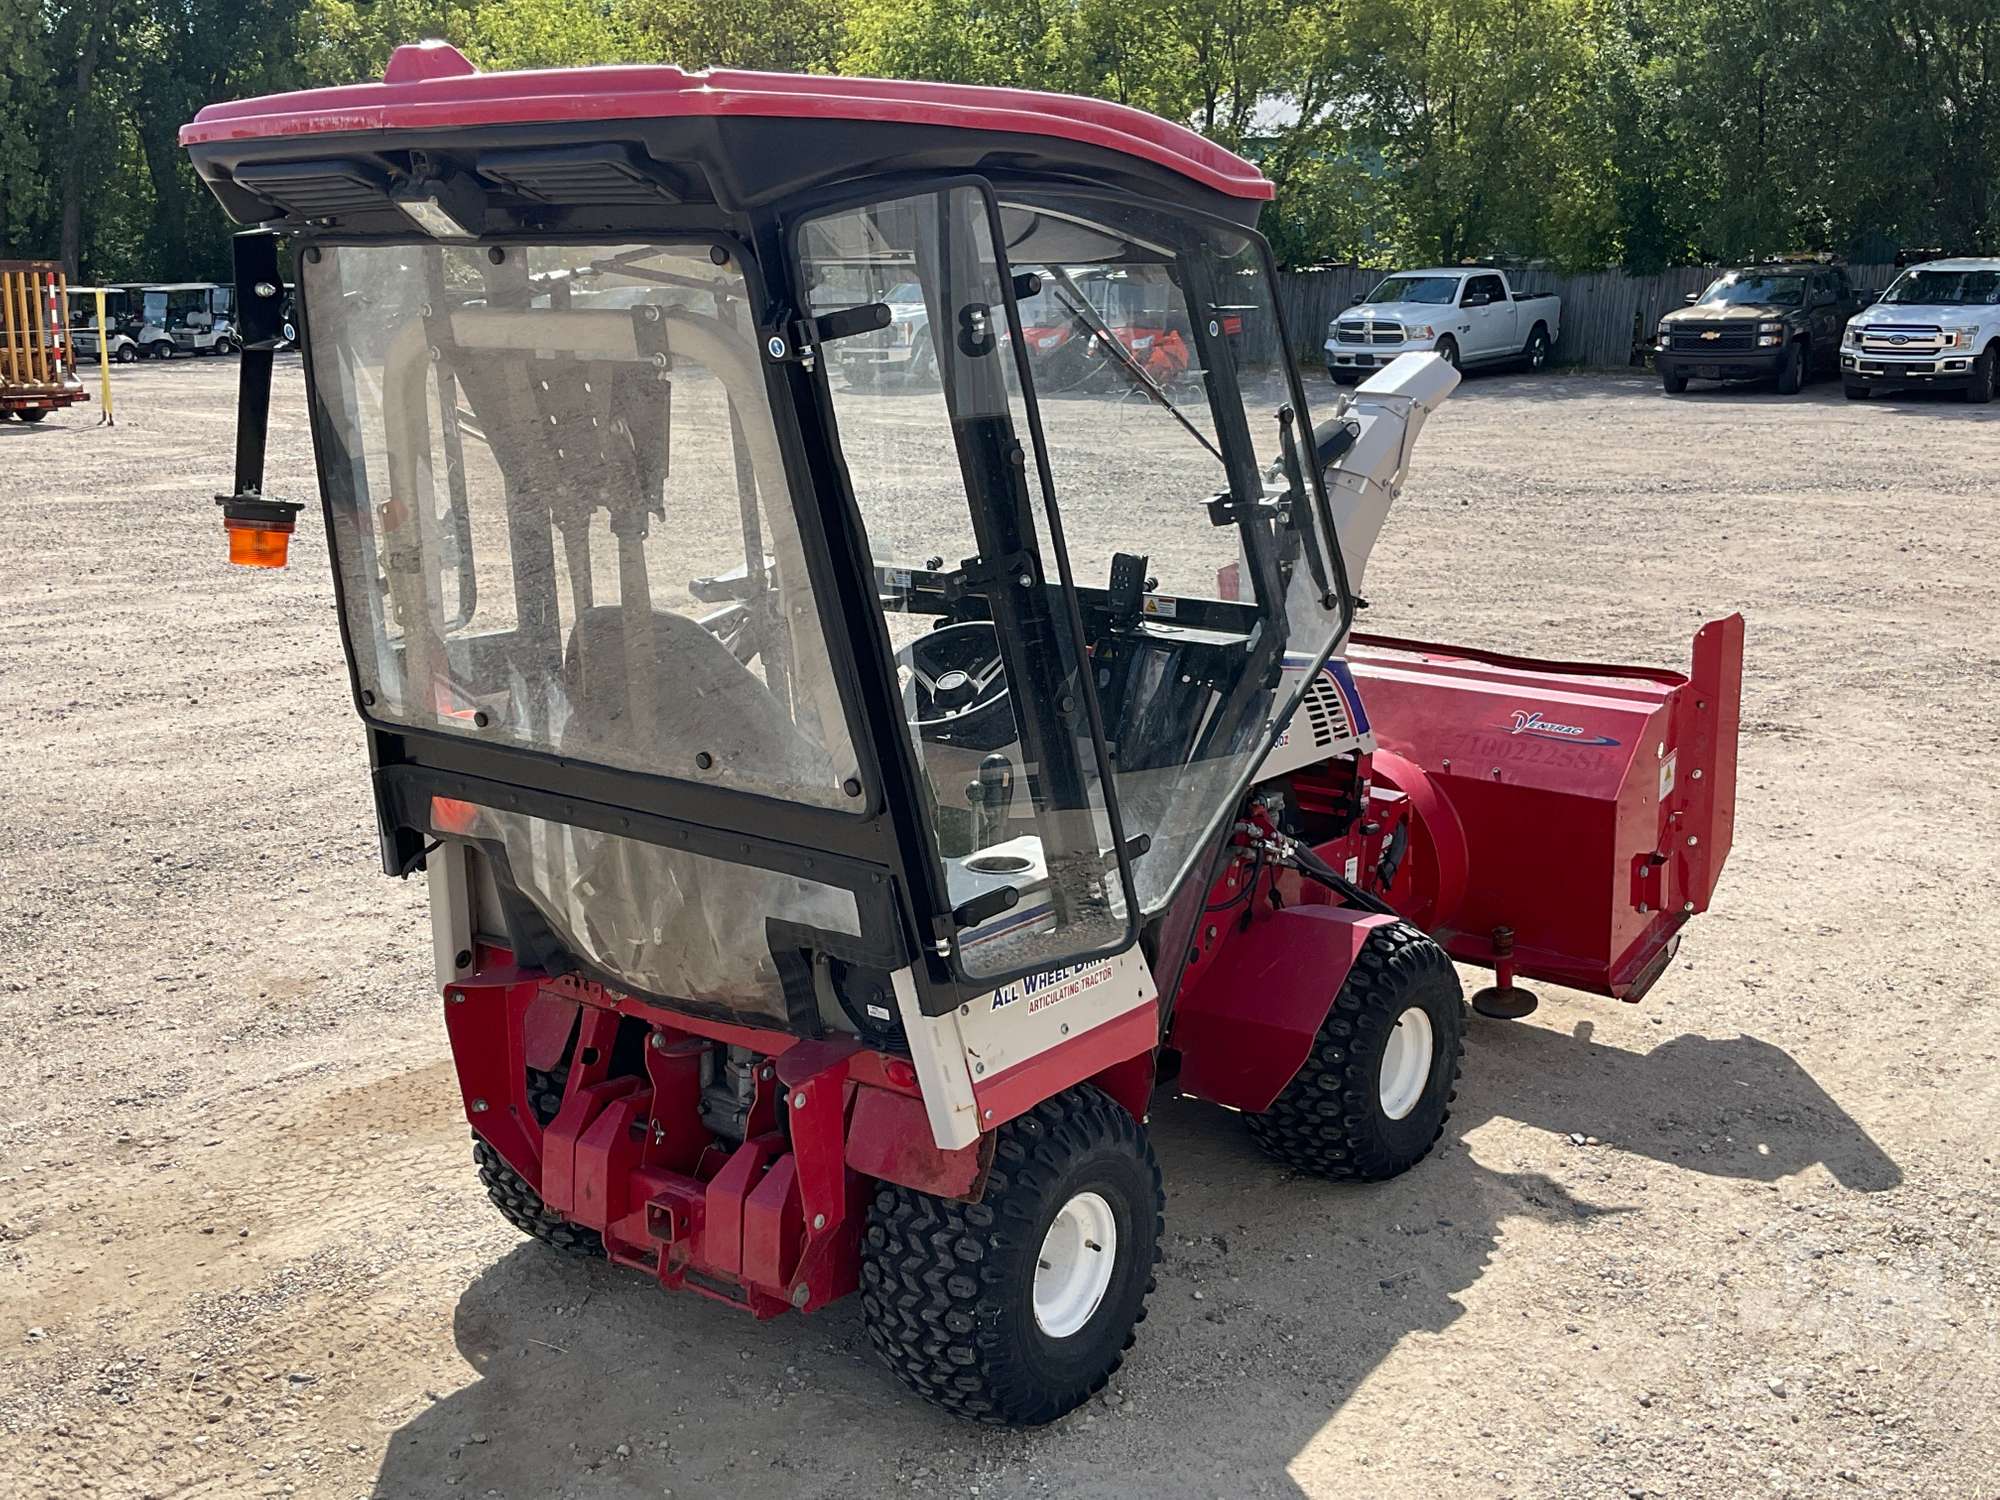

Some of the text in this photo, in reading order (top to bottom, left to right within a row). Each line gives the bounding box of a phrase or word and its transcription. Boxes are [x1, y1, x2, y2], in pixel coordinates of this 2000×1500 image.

[1511, 710, 1584, 735] VENTRAC
[992, 967, 1070, 1010] ALL WHEEL
[1028, 967, 1112, 1014] ARTICULATING TRACTOR
